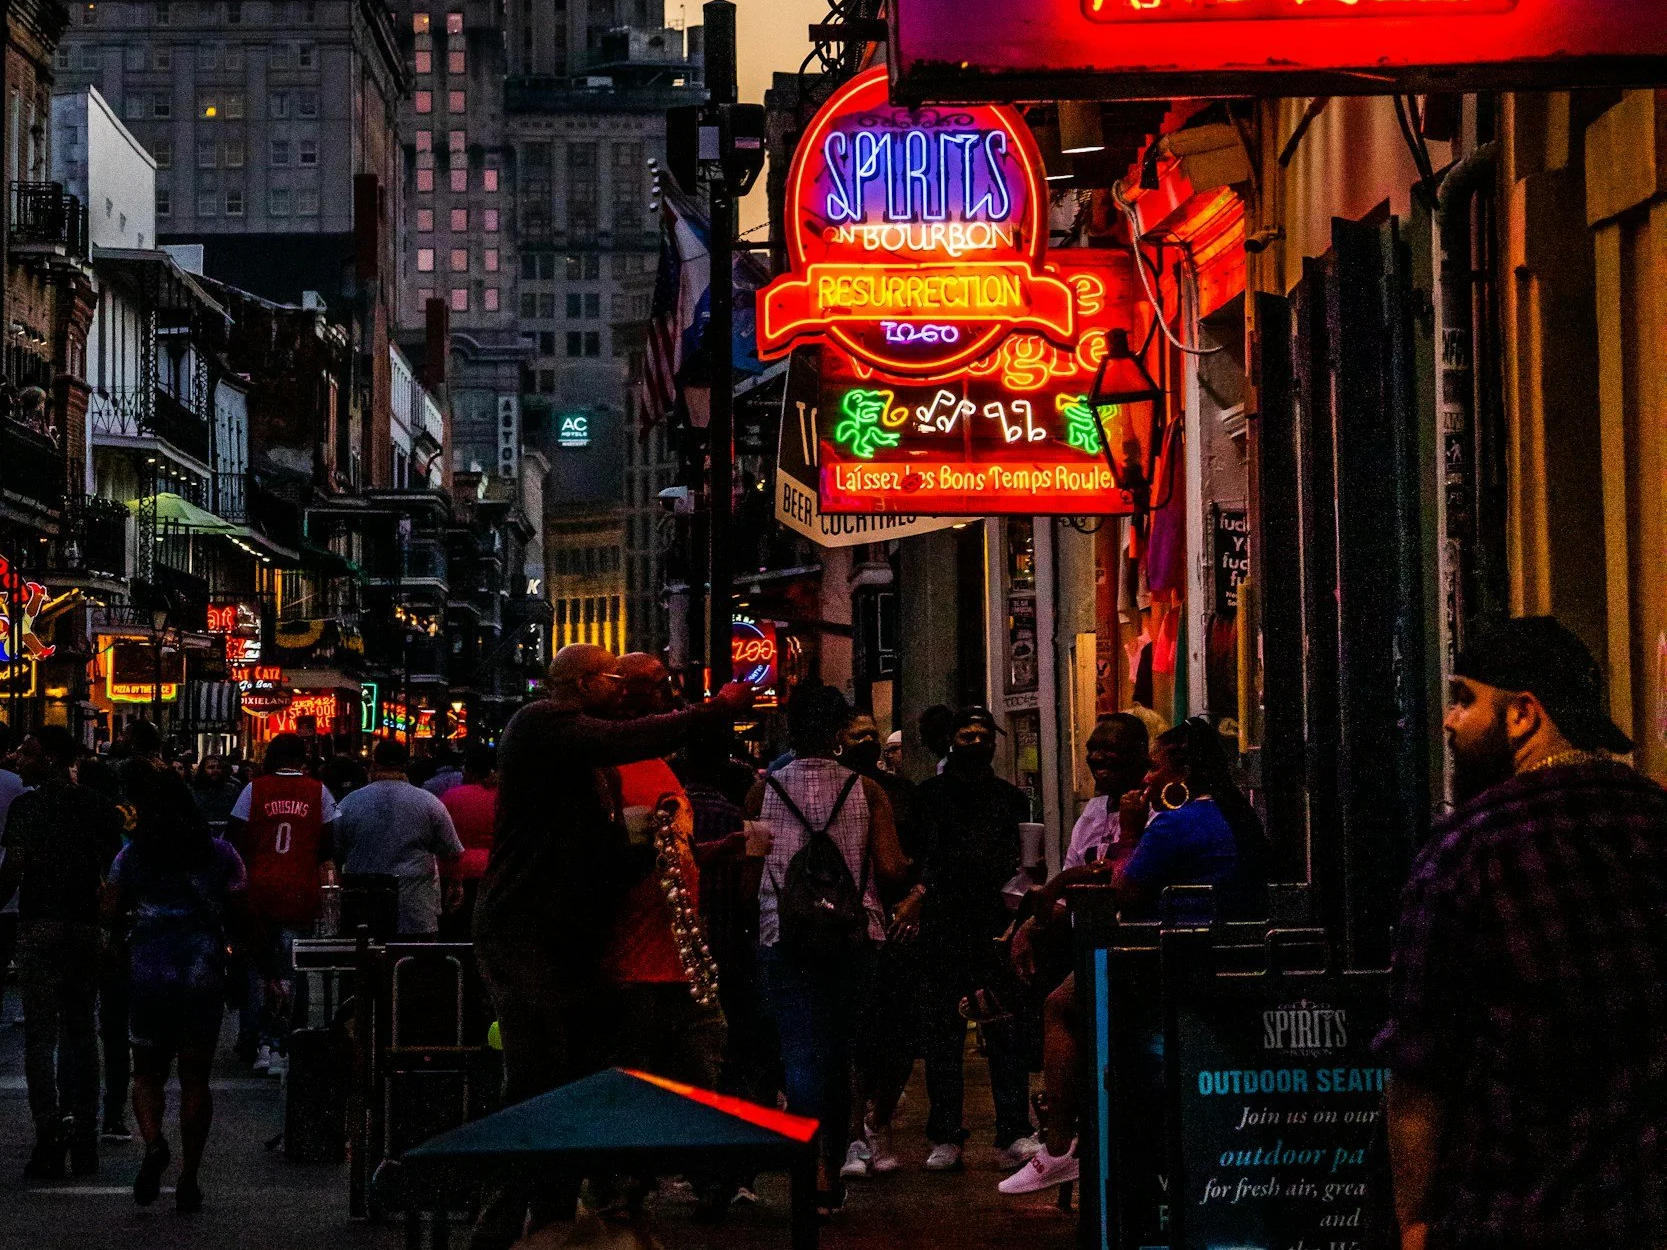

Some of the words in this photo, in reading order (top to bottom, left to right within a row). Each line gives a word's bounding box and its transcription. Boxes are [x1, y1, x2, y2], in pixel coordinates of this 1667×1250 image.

[824, 129, 1012, 222] SPIRITS
[862, 222, 1014, 257] BOURBON
[817, 274, 1022, 308] RESURRECTION
[561, 416, 588, 432] AC
[940, 465, 985, 490] Bons
[989, 465, 1051, 493] Temps
[783, 482, 813, 527] BEER
[254, 665, 281, 680] CATZ
[112, 685, 131, 694] PIZZA
[153, 685, 171, 694] SCE
[264, 800, 309, 818] COUSINS
[275, 821, 292, 854] 0
[1262, 1008, 1348, 1050] SPIRITS
[1197, 1067, 1309, 1096] OUTDOOR
[1235, 1106, 1280, 1131] Join
[1286, 1111, 1308, 1125] us
[1312, 1110, 1338, 1124] on
[1343, 1109, 1380, 1123] our
[1219, 1137, 1326, 1167] outdoor
[1199, 1177, 1231, 1205] for
[1230, 1176, 1280, 1205] fresh
[1285, 1181, 1318, 1199] air,
[1319, 1207, 1361, 1227] and
